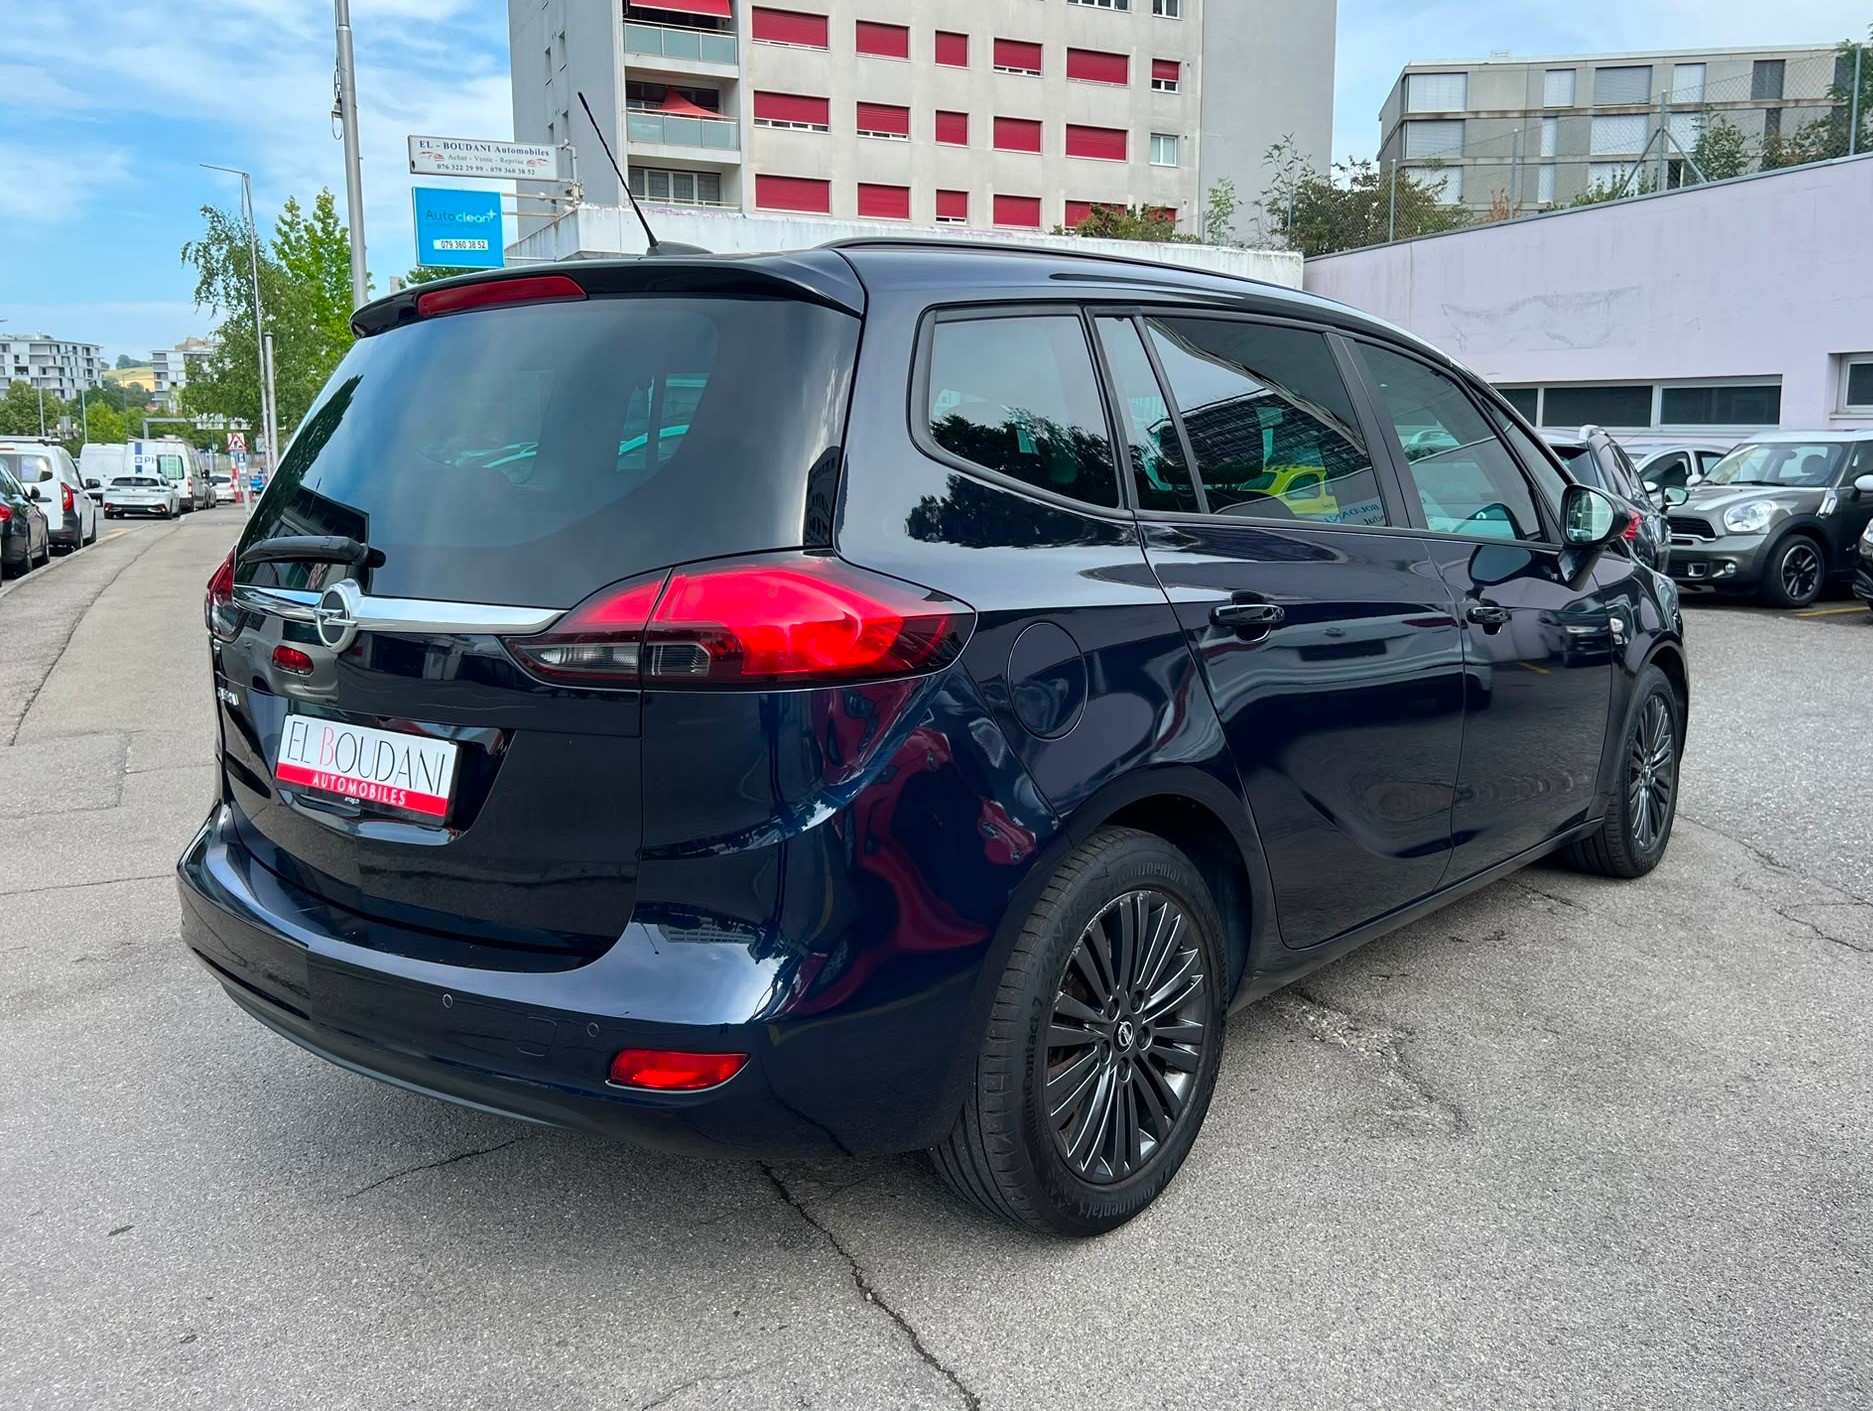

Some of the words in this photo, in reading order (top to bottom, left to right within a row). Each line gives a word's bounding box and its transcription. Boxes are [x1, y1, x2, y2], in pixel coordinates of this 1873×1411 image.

[419, 140, 433, 149] EL
[443, 142, 491, 152] BOUDANI
[495, 146, 549, 156] Automobiles
[477, 241, 486, 249] 52
[287, 721, 311, 764] EL
[319, 726, 446, 796] BOUDANI
[311, 773, 406, 806] AUTOMOBILES
